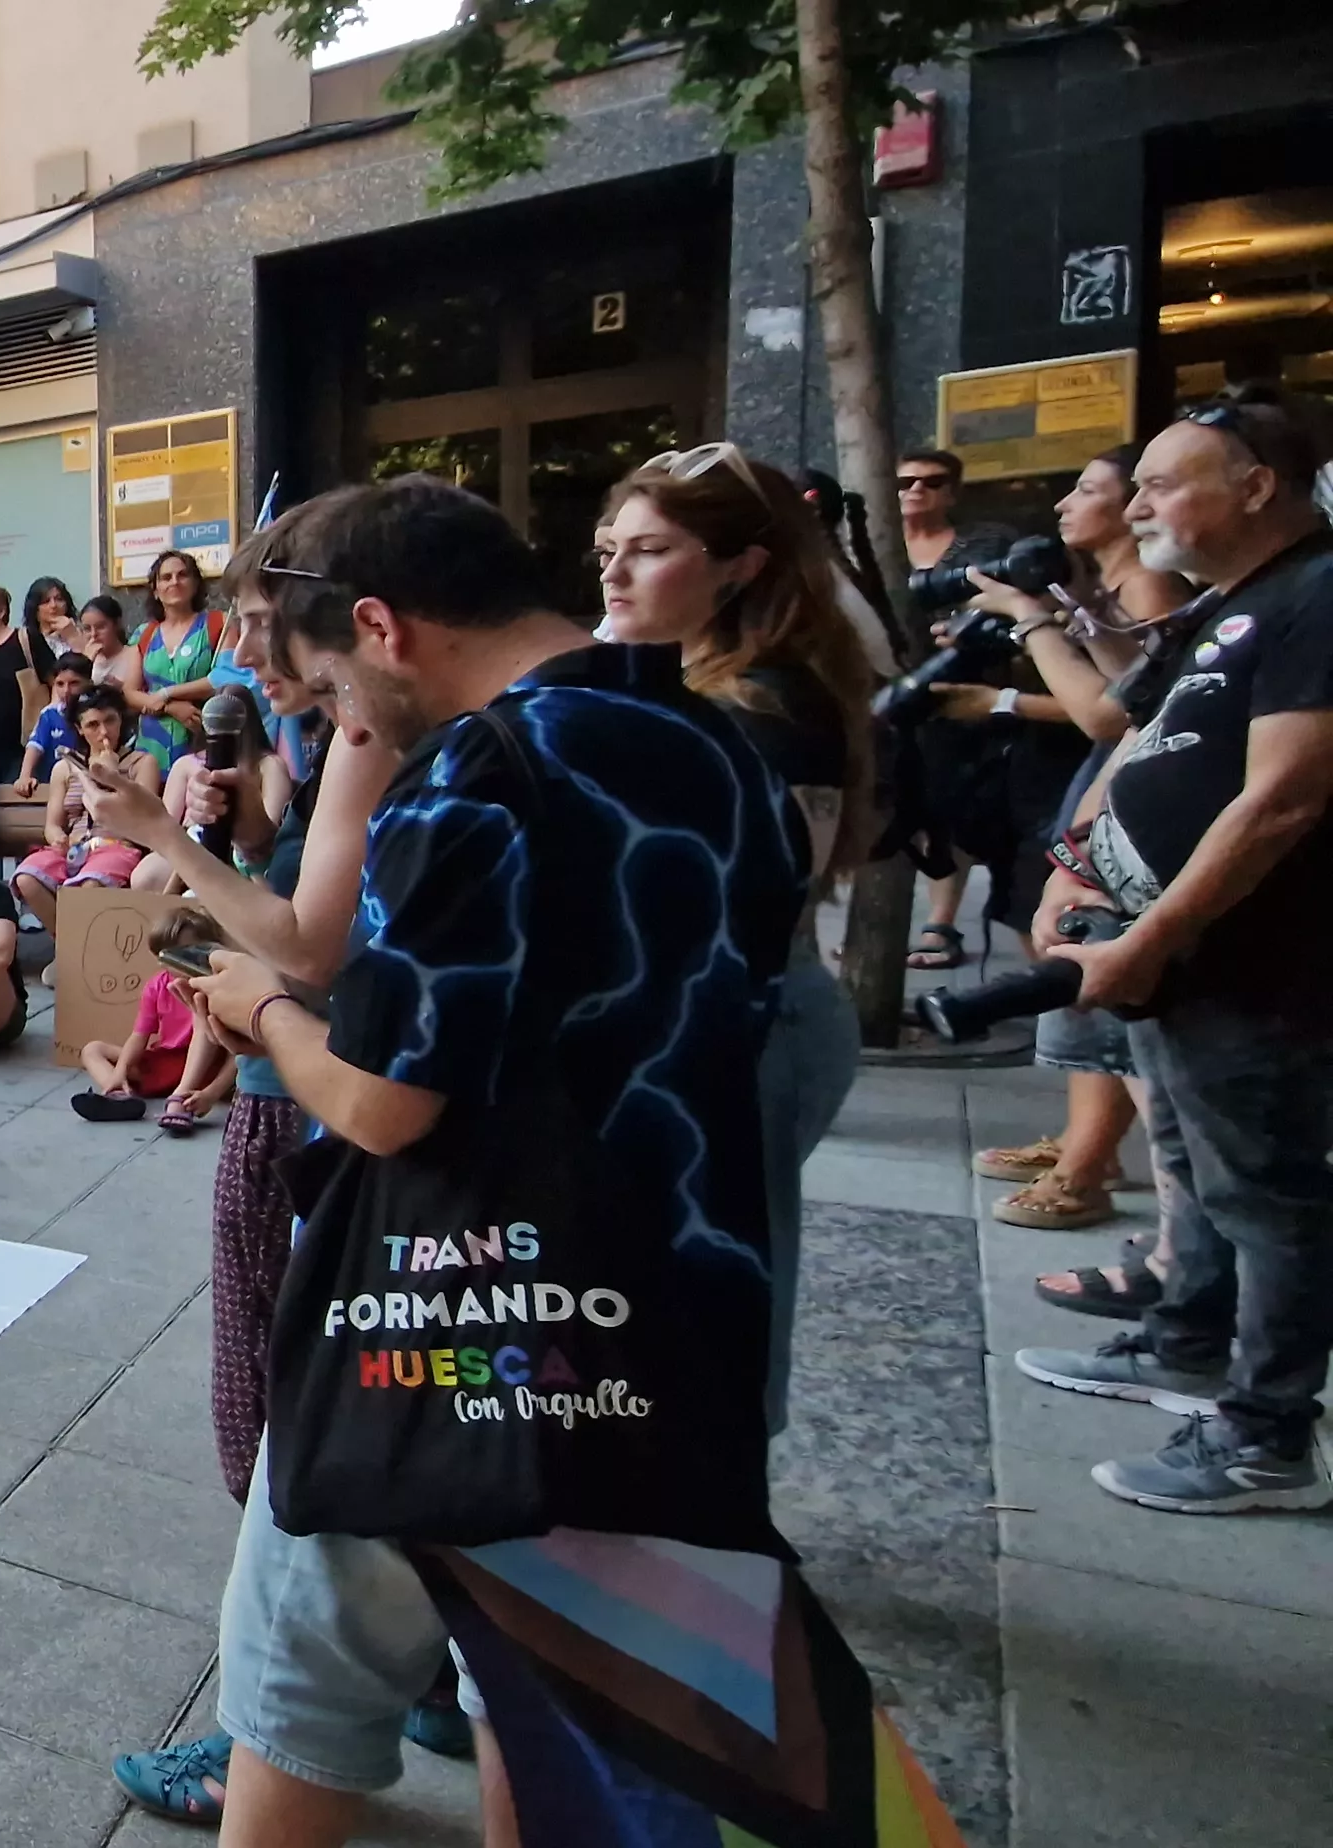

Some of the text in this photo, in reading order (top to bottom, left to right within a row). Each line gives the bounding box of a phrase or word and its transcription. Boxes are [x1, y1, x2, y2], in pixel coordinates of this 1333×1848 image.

[598, 296, 620, 328] 2
[383, 1221, 540, 1273] TRANS
[324, 1283, 631, 1337] FORMANDO
[359, 1345, 581, 1388] HUESCA
[516, 1378, 653, 1430] Orgullo
